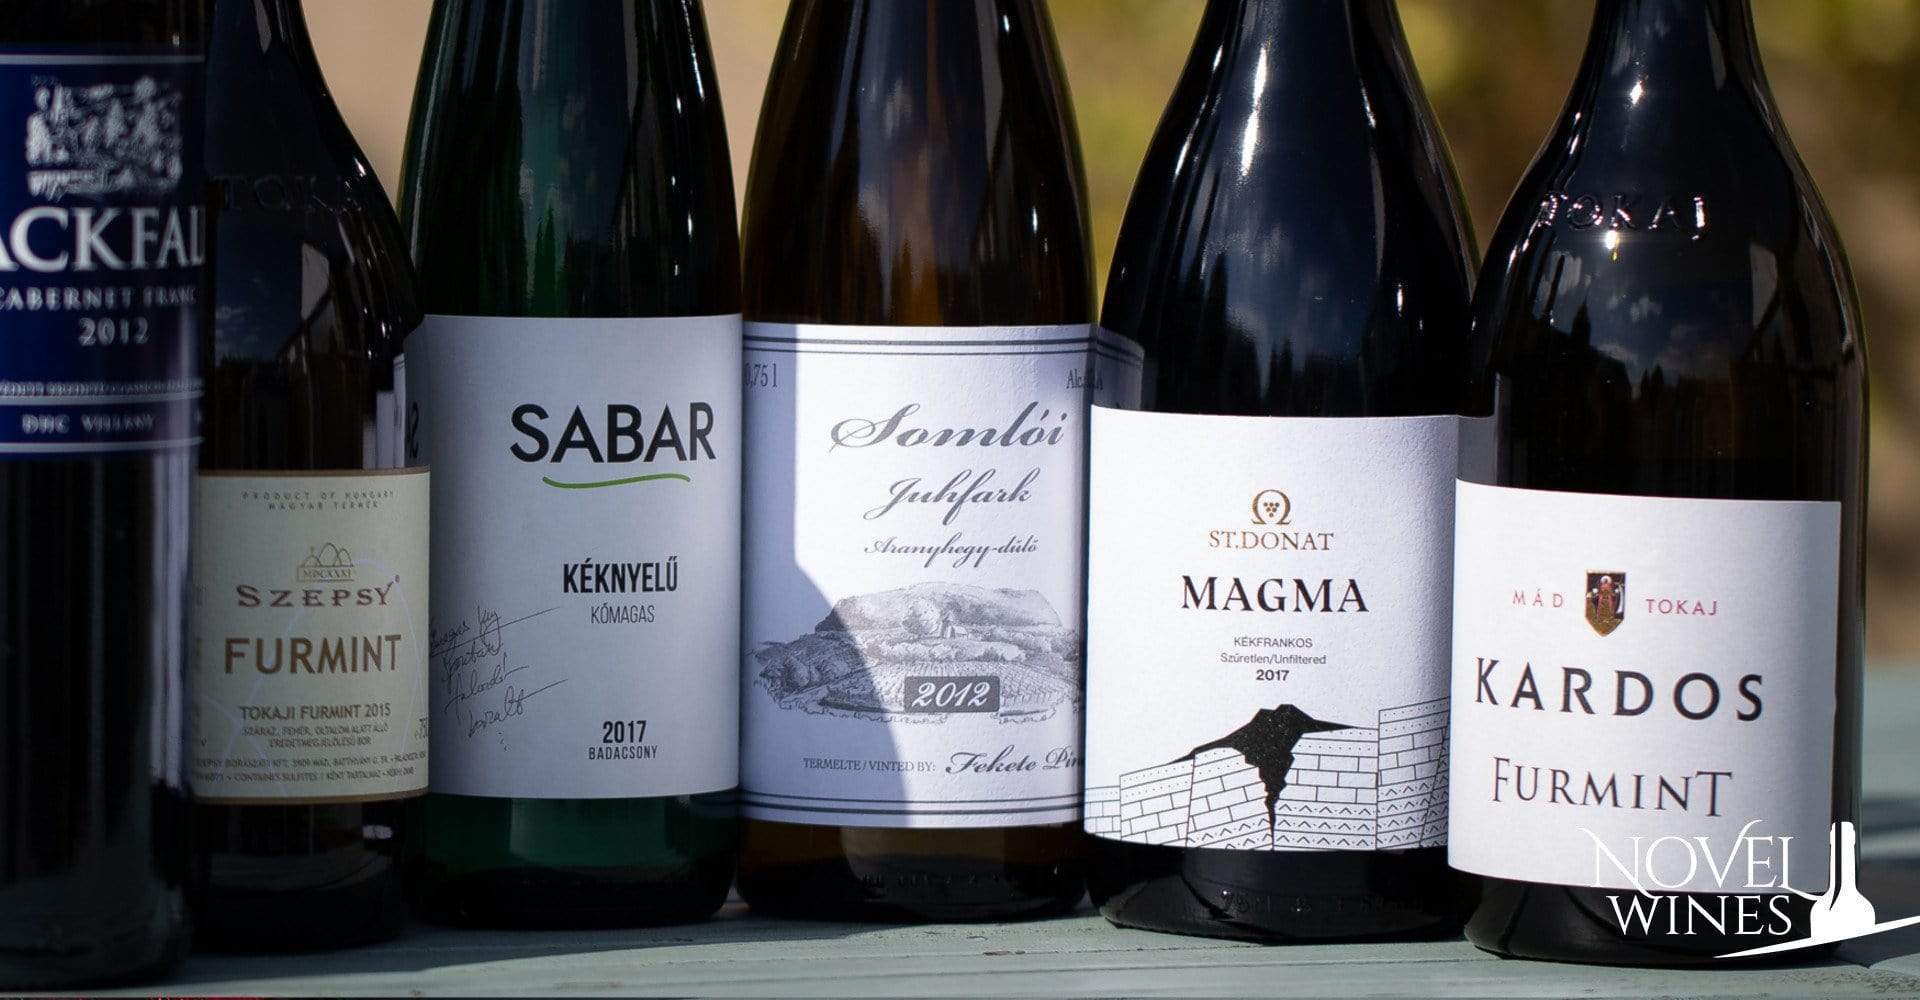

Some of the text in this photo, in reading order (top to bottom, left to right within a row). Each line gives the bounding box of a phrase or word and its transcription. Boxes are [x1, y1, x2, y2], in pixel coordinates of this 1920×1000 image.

[78, 316, 150, 346] 2012
[509, 402, 717, 463] SABAR
[829, 401, 1068, 453] Somlói
[863, 467, 1041, 526] Juhfark
[1209, 530, 1334, 551] ST.DONAT
[563, 556, 679, 593] KÉKNYELŰ
[236, 581, 394, 608] SZEPSY
[1181, 575, 1370, 613] MAGMA
[1512, 587, 1719, 616] MÁD TOKAJ
[225, 634, 401, 675] FURMINT
[1233, 636, 1313, 648] KÉKFRANKOS
[1255, 669, 1290, 681] 2017
[1474, 656, 1763, 721] KARDOS
[911, 681, 992, 708] 2012
[239, 702, 392, 721] TOKAJI FURMINT 2015
[602, 720, 647, 743] 2017
[588, 745, 658, 760] BADACSONY
[802, 757, 861, 771] TERMELTE
[869, 759, 914, 772] VINTED
[945, 744, 1038, 774] Fekete
[1492, 756, 1733, 817] FURMINT
